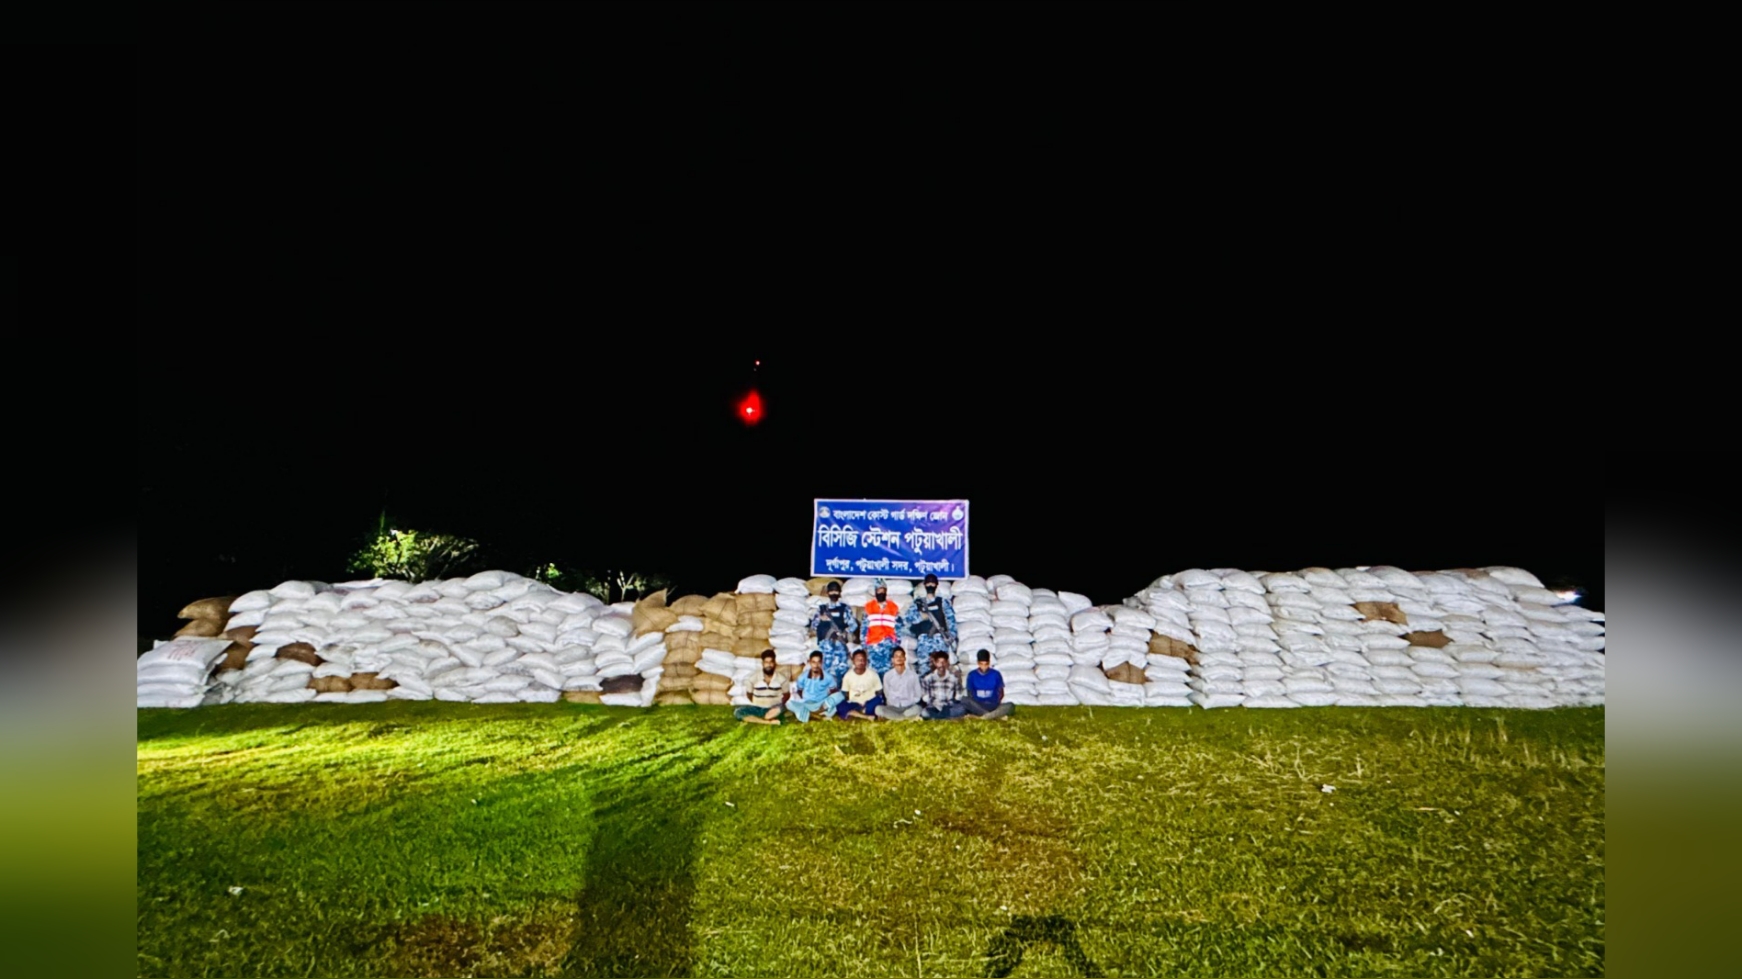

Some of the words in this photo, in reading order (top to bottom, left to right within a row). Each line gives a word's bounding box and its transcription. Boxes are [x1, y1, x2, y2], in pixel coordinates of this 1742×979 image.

[833, 510, 867, 521] বাংলাদেশ
[867, 509, 890, 521] কোস্ট
[891, 509, 906, 521] গার্ড
[818, 524, 859, 548] বিসিজি
[861, 526, 901, 549] স্টেশন
[904, 526, 963, 555] পটুয়াখালী
[855, 557, 890, 572] পটুয়াখালী
